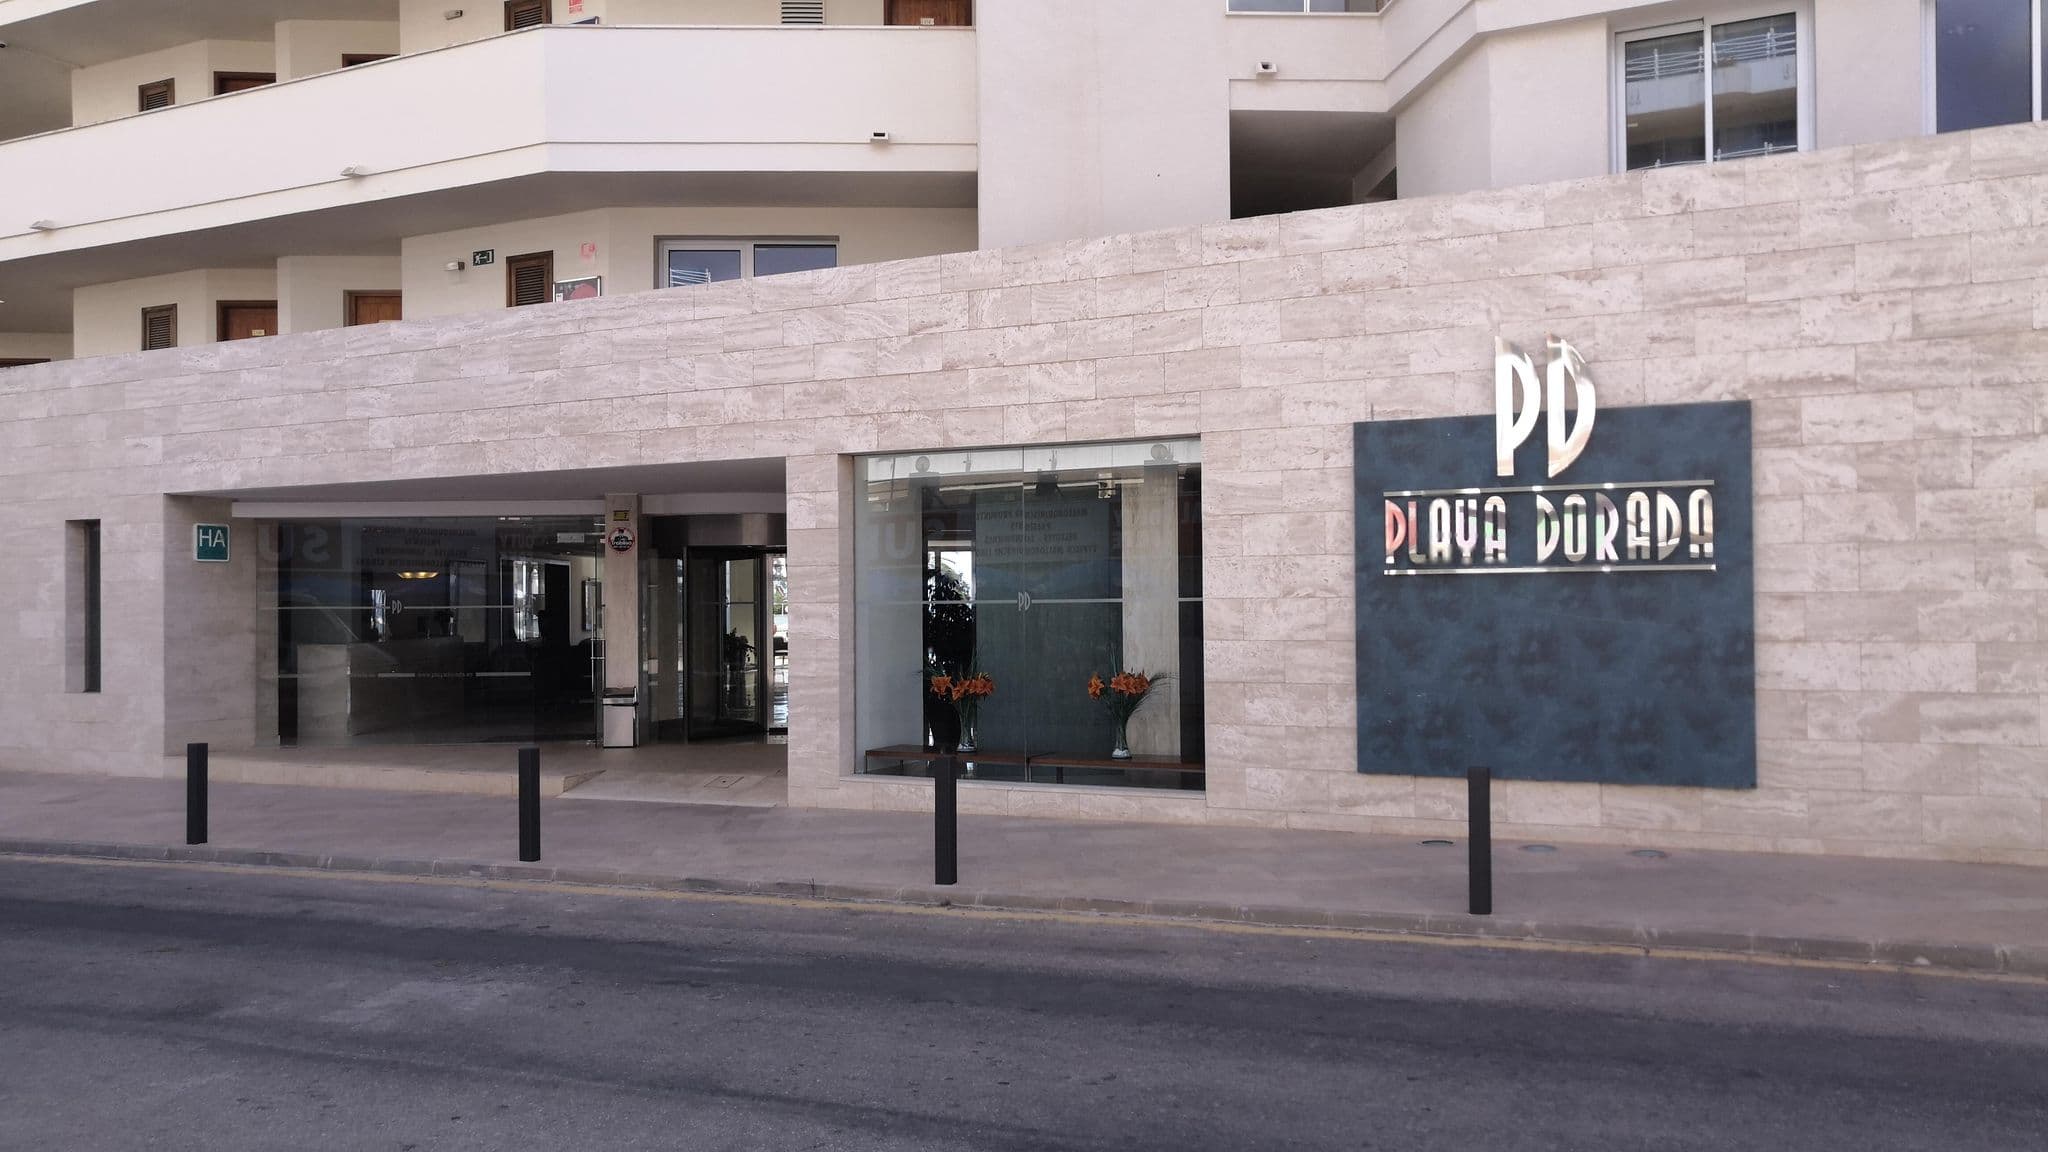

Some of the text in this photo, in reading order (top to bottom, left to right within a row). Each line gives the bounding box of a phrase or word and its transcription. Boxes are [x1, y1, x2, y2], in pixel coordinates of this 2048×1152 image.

[1494, 334, 1596, 478] PD
[1384, 490, 1714, 564] PLAYA DORADA
[199, 528, 226, 548] HA
[391, 599, 402, 614] PD
[1017, 591, 1031, 611] PD
